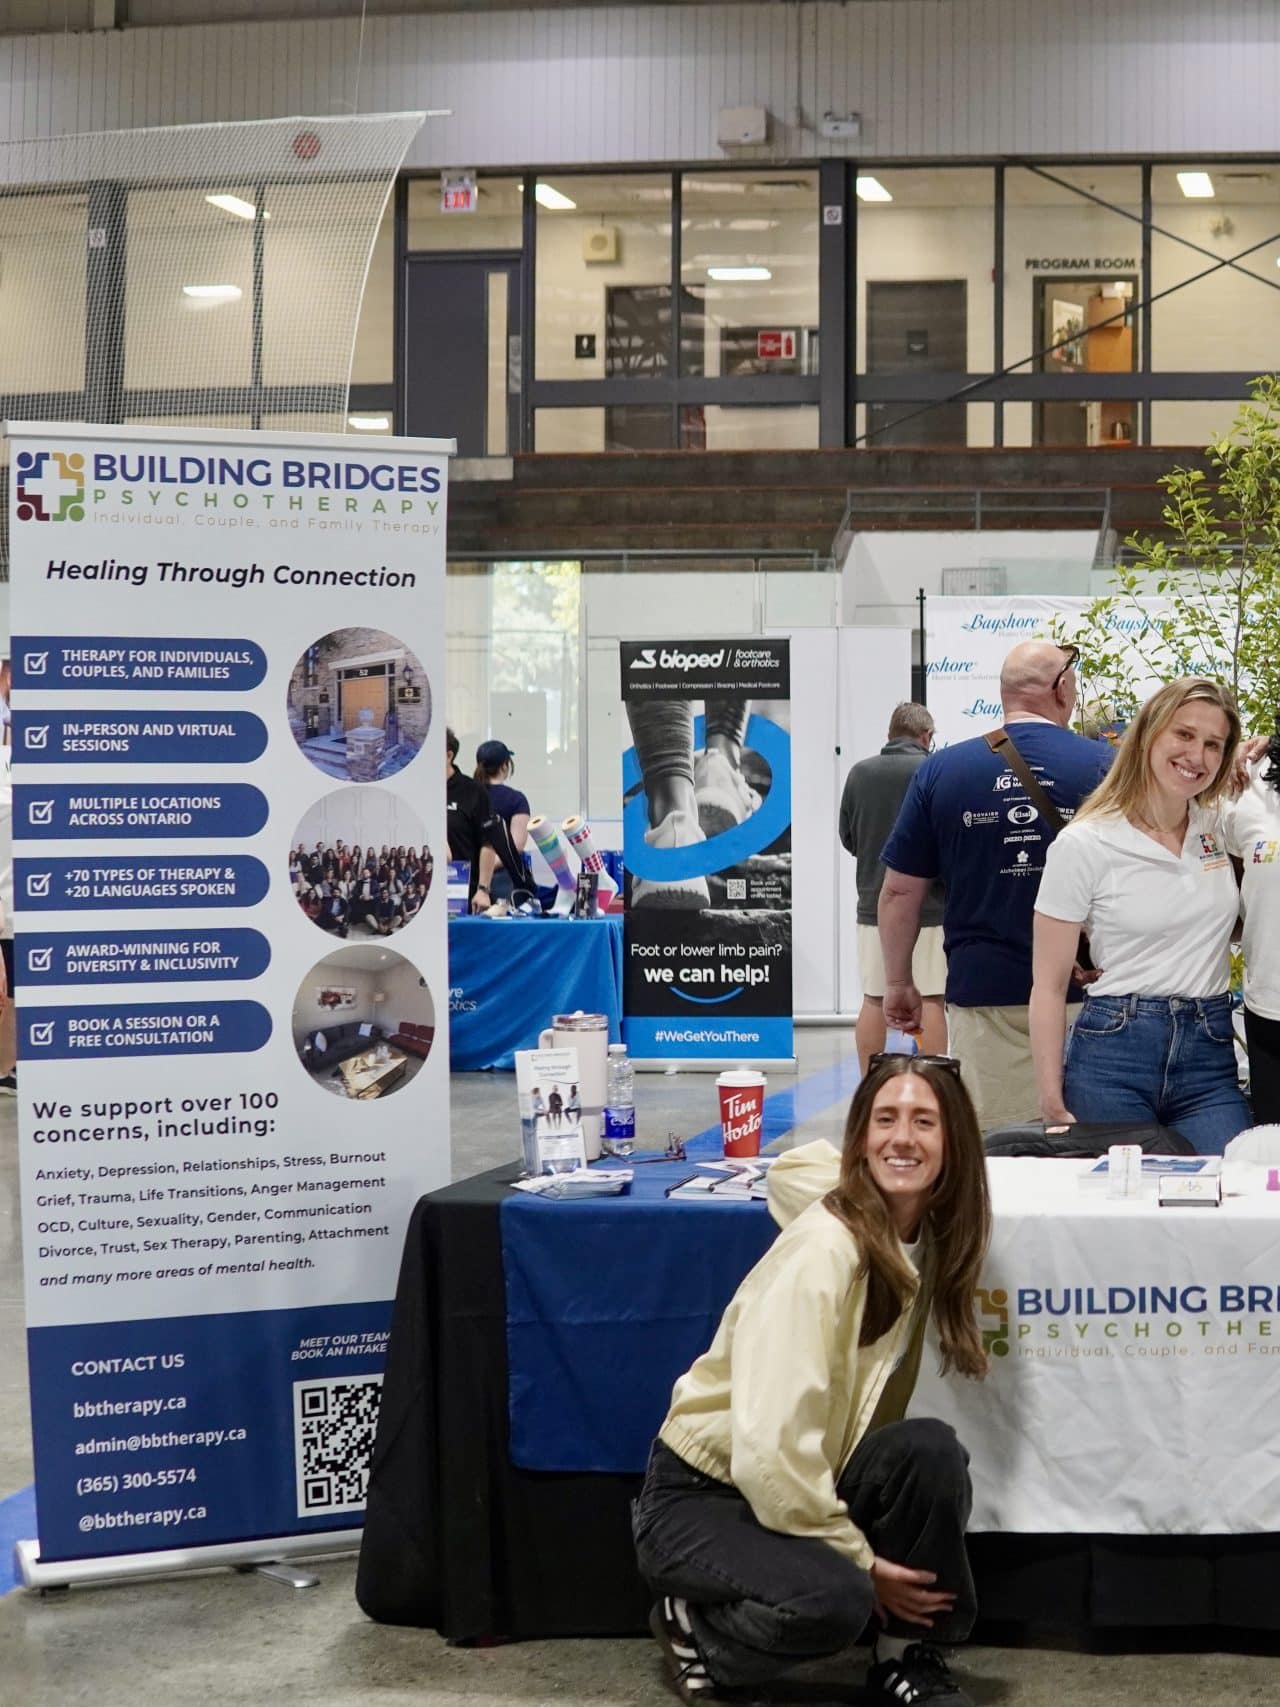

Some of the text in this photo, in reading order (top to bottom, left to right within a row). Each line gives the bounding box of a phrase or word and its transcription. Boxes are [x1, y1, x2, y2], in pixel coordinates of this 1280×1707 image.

[1025, 258, 1136, 269] PROGRAM ROOM
[93, 453, 441, 493] BUILDING BRIDGES
[93, 489, 440, 515] PSYCHOTHERAPY
[94, 511, 441, 536] Individual, Couple, and Family Therapy
[47, 560, 416, 588] Healing Through Connection
[970, 612, 1040, 633] Bayshore
[62, 649, 254, 667] THERAPY FOR INDIVIDUALS,
[659, 649, 724, 671] bioped
[735, 649, 772, 659] footcare
[741, 657, 780, 668] orthotics
[62, 664, 230, 680] COUPLES, AND FAMILIES
[63, 723, 236, 738] IN-PERSON AND VIRTUAL
[63, 738, 129, 753] SESSIONS
[69, 796, 221, 811] MULTIPLE LOCATIONS
[69, 812, 192, 826] ACROSS ONTARIO
[64, 868, 235, 883] +70 TYPES OF THERAPY &
[64, 883, 236, 899] +20 LANGUAGES SPOKEN
[66, 941, 221, 958] AWARD-WINNING FOR
[631, 944, 783, 959] Foot or lower limb pain?
[67, 955, 239, 973] DIVERSITY & INCLUSIVITY
[644, 964, 770, 985] we can help!
[68, 1030, 214, 1048] FREE CONSULTATION
[655, 1030, 760, 1043] #WeGetYouThere
[33, 1092, 279, 1120] We support over 100
[723, 1093, 757, 1119] Tim
[33, 1117, 276, 1145] concerns, including:
[36, 1151, 386, 1182] Anxiety, Depression, Relationships, Stress, Burnout
[37, 1176, 386, 1208] Grief, Trauma, Life Transitions, Anger Management
[38, 1203, 372, 1236] OCD, Culture, Sexuality, Gender, Communication
[39, 1224, 390, 1259] Divorce, Trust, Sex Therapy, Parenting, Attachment
[1018, 1286, 1207, 1316] BUILDING
[299, 1337, 330, 1348] MEET
[332, 1334, 359, 1346] OUR
[1204, 1342, 1238, 1355] and
[291, 1344, 388, 1361] BOOK AN INTAKE
[71, 1353, 185, 1376] CONTACT US
[73, 1395, 187, 1419] bbtherapy.ca
[75, 1426, 247, 1456] admin@bbtherapy.ca
[76, 1467, 197, 1496] (365) 300-5574
[79, 1504, 207, 1532] @bbtherapy.ca
